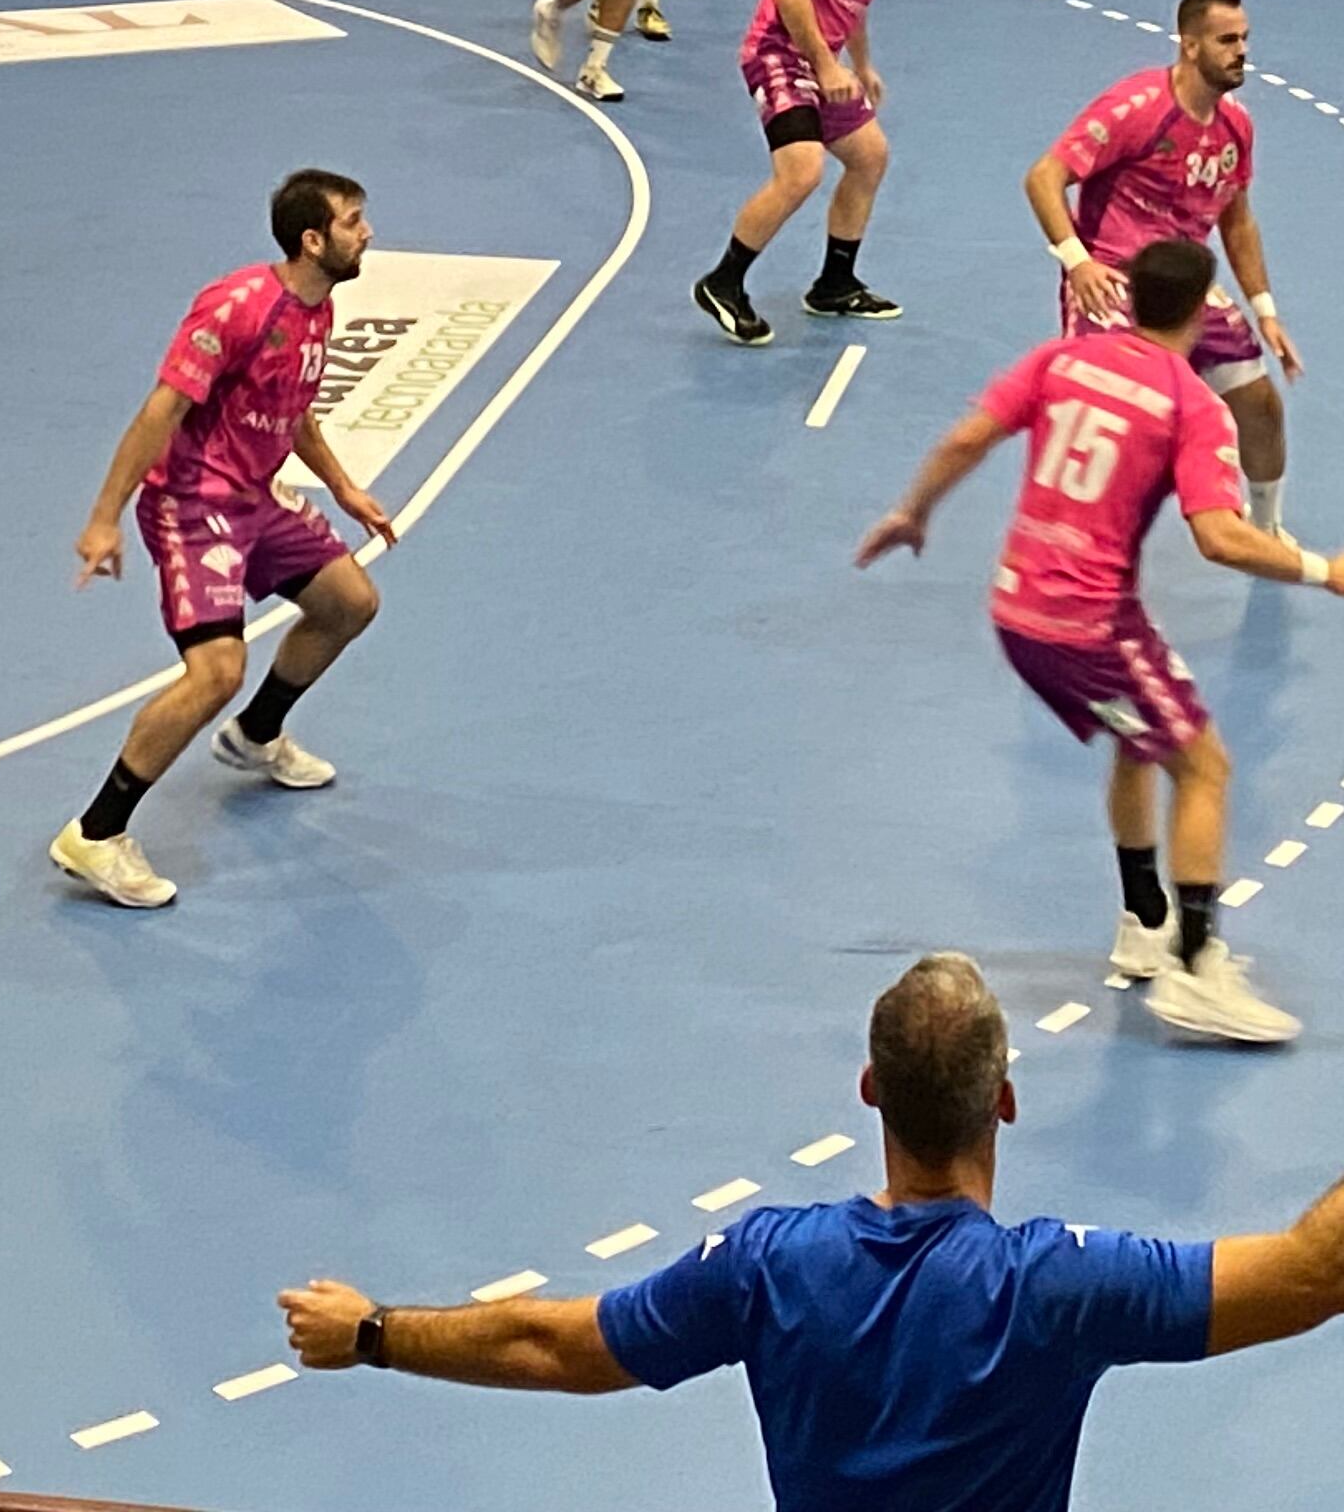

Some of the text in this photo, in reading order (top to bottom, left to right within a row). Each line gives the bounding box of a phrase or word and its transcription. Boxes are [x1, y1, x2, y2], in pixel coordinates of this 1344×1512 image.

[1183, 150, 1220, 189] 34
[299, 341, 325, 383] 13
[334, 299, 511, 432] tecnoaranda
[1034, 396, 1132, 505] 15
